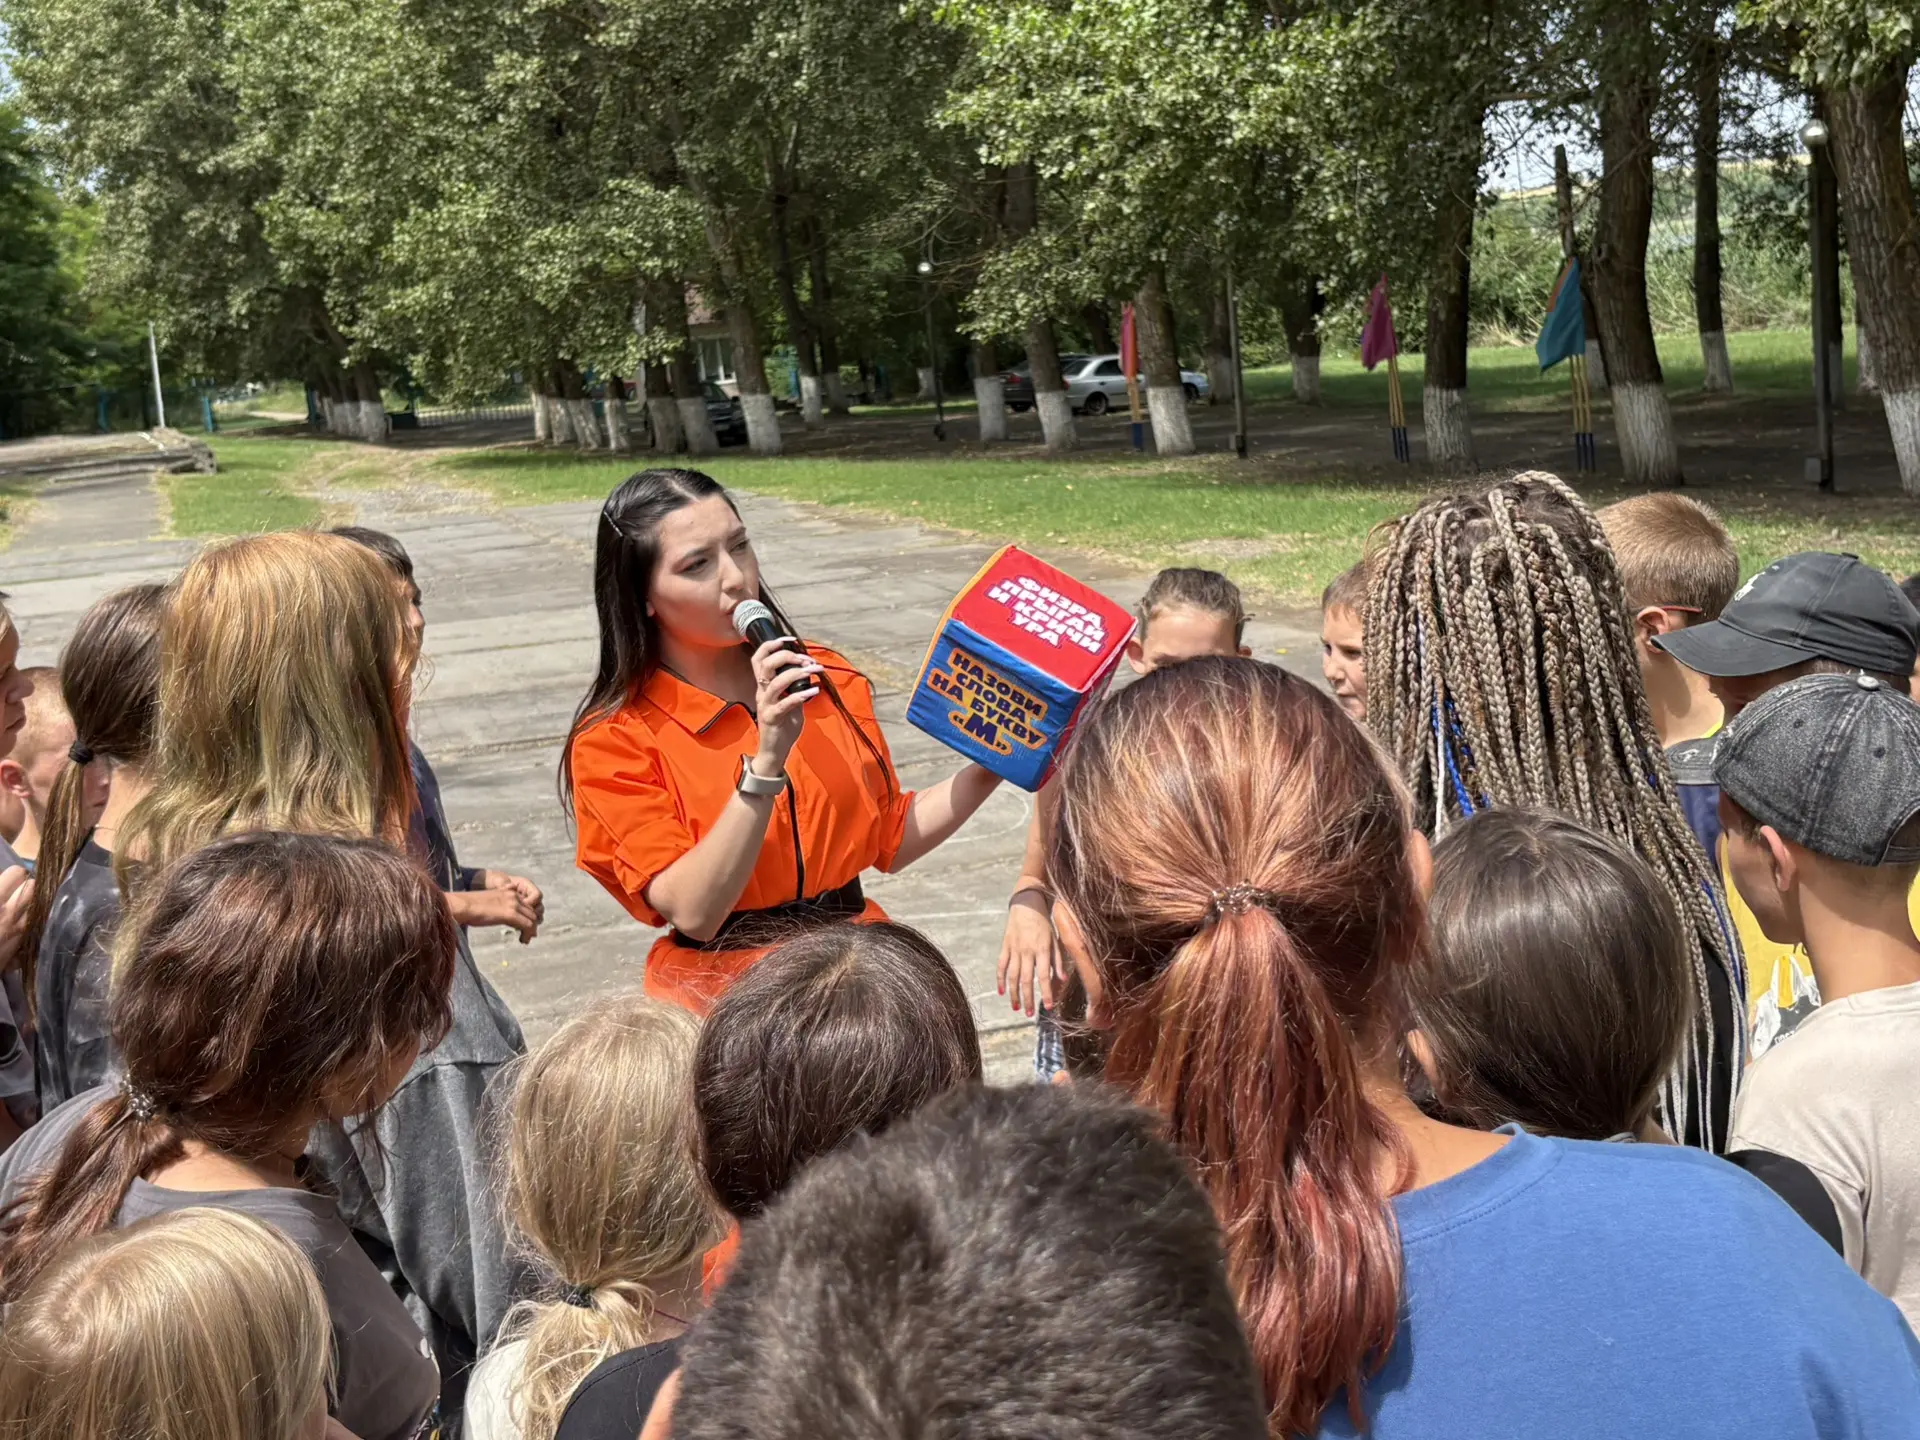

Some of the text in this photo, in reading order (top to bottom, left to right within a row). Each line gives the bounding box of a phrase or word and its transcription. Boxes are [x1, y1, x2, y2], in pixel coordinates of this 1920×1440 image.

[988, 586, 1101, 654] И КРИЧИ
[1012, 613, 1060, 646] УРА
[1017, 576, 1103, 628] ФИЗРА
[932, 673, 1042, 744] НА БУКВУ
[953, 652, 1042, 716] НАЗОВИ
[956, 673, 1025, 722] СЛОВА
